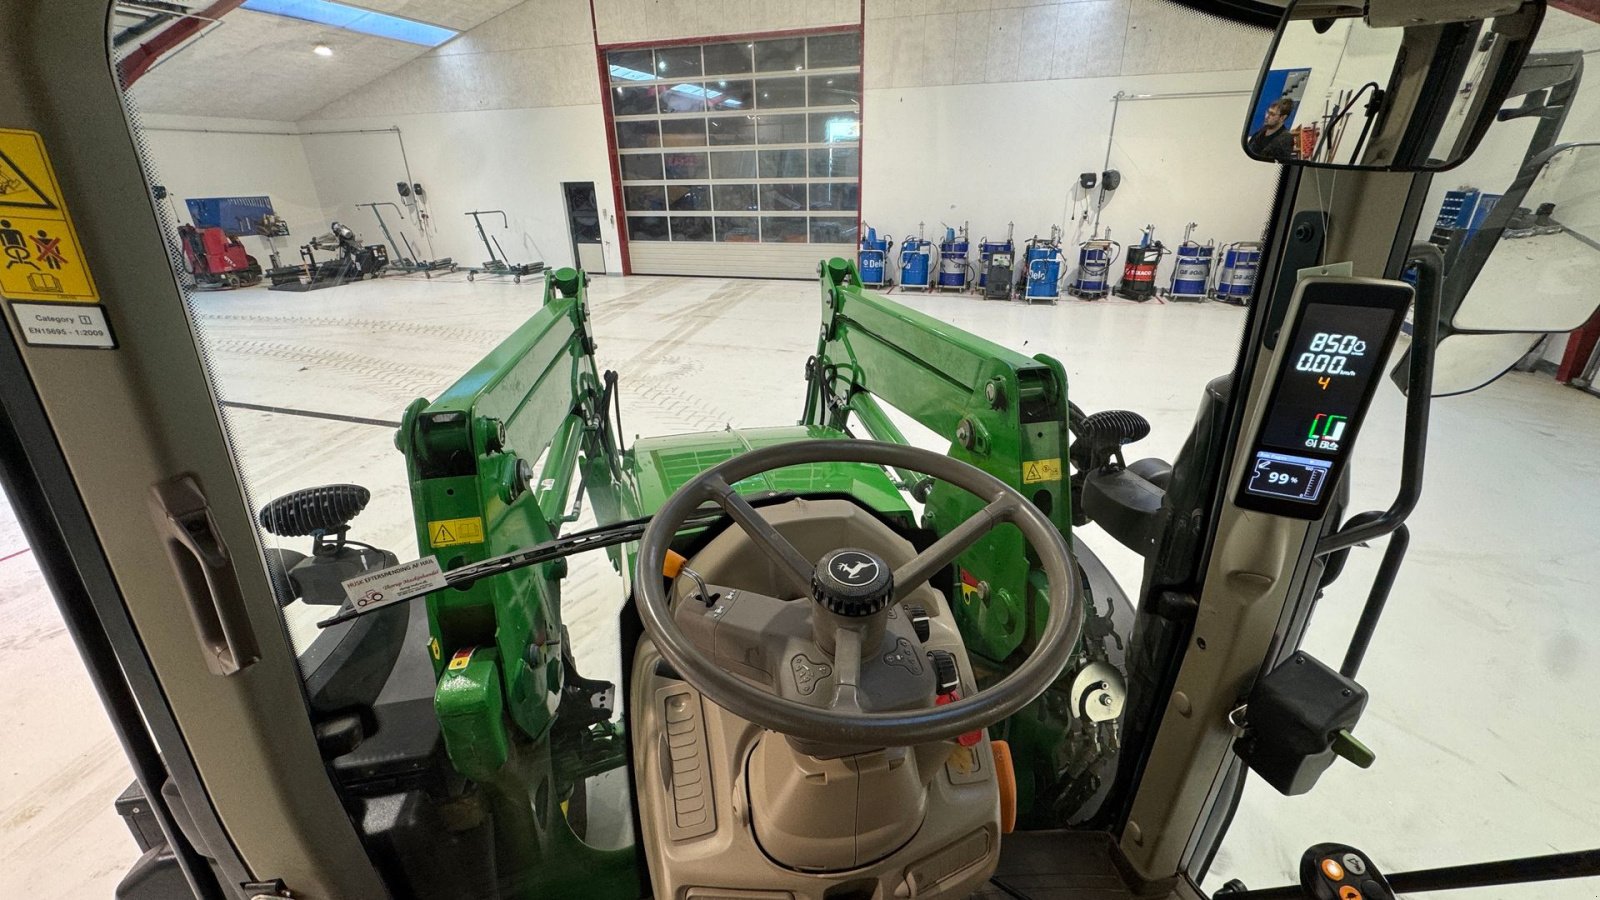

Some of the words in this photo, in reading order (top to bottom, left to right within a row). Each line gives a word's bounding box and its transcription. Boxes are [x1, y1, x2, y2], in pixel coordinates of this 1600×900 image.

[35, 314, 75, 324] Category
[1310, 332, 1357, 354] 850
[1297, 352, 1347, 374] 0.00
[1318, 376, 1331, 390] 4
[1268, 471, 1290, 485] 99
